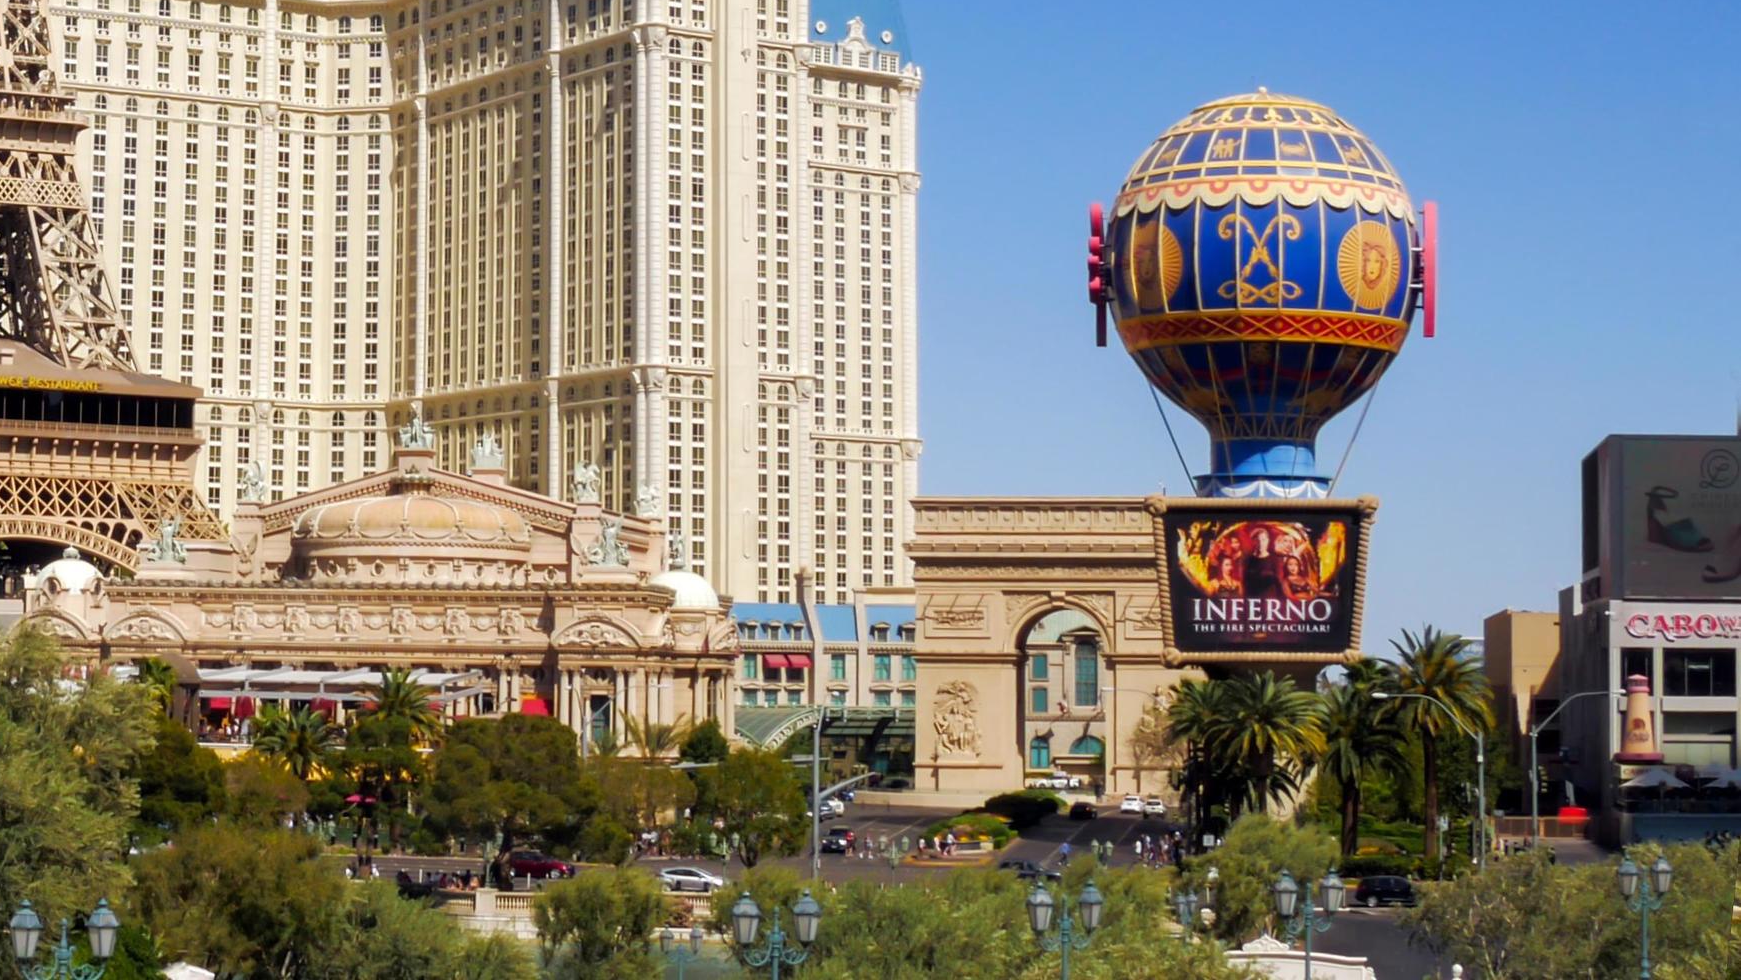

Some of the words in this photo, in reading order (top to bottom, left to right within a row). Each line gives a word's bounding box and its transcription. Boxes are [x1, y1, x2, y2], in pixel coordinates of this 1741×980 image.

[27, 375, 99, 392] RESTAURANT
[1193, 598, 1332, 621] INFERNO
[1193, 623, 1216, 633] THE
[1220, 623, 1244, 633] FIRE
[1249, 623, 1330, 633] SPECTACULAR!
[1625, 614, 1718, 642] CABO
